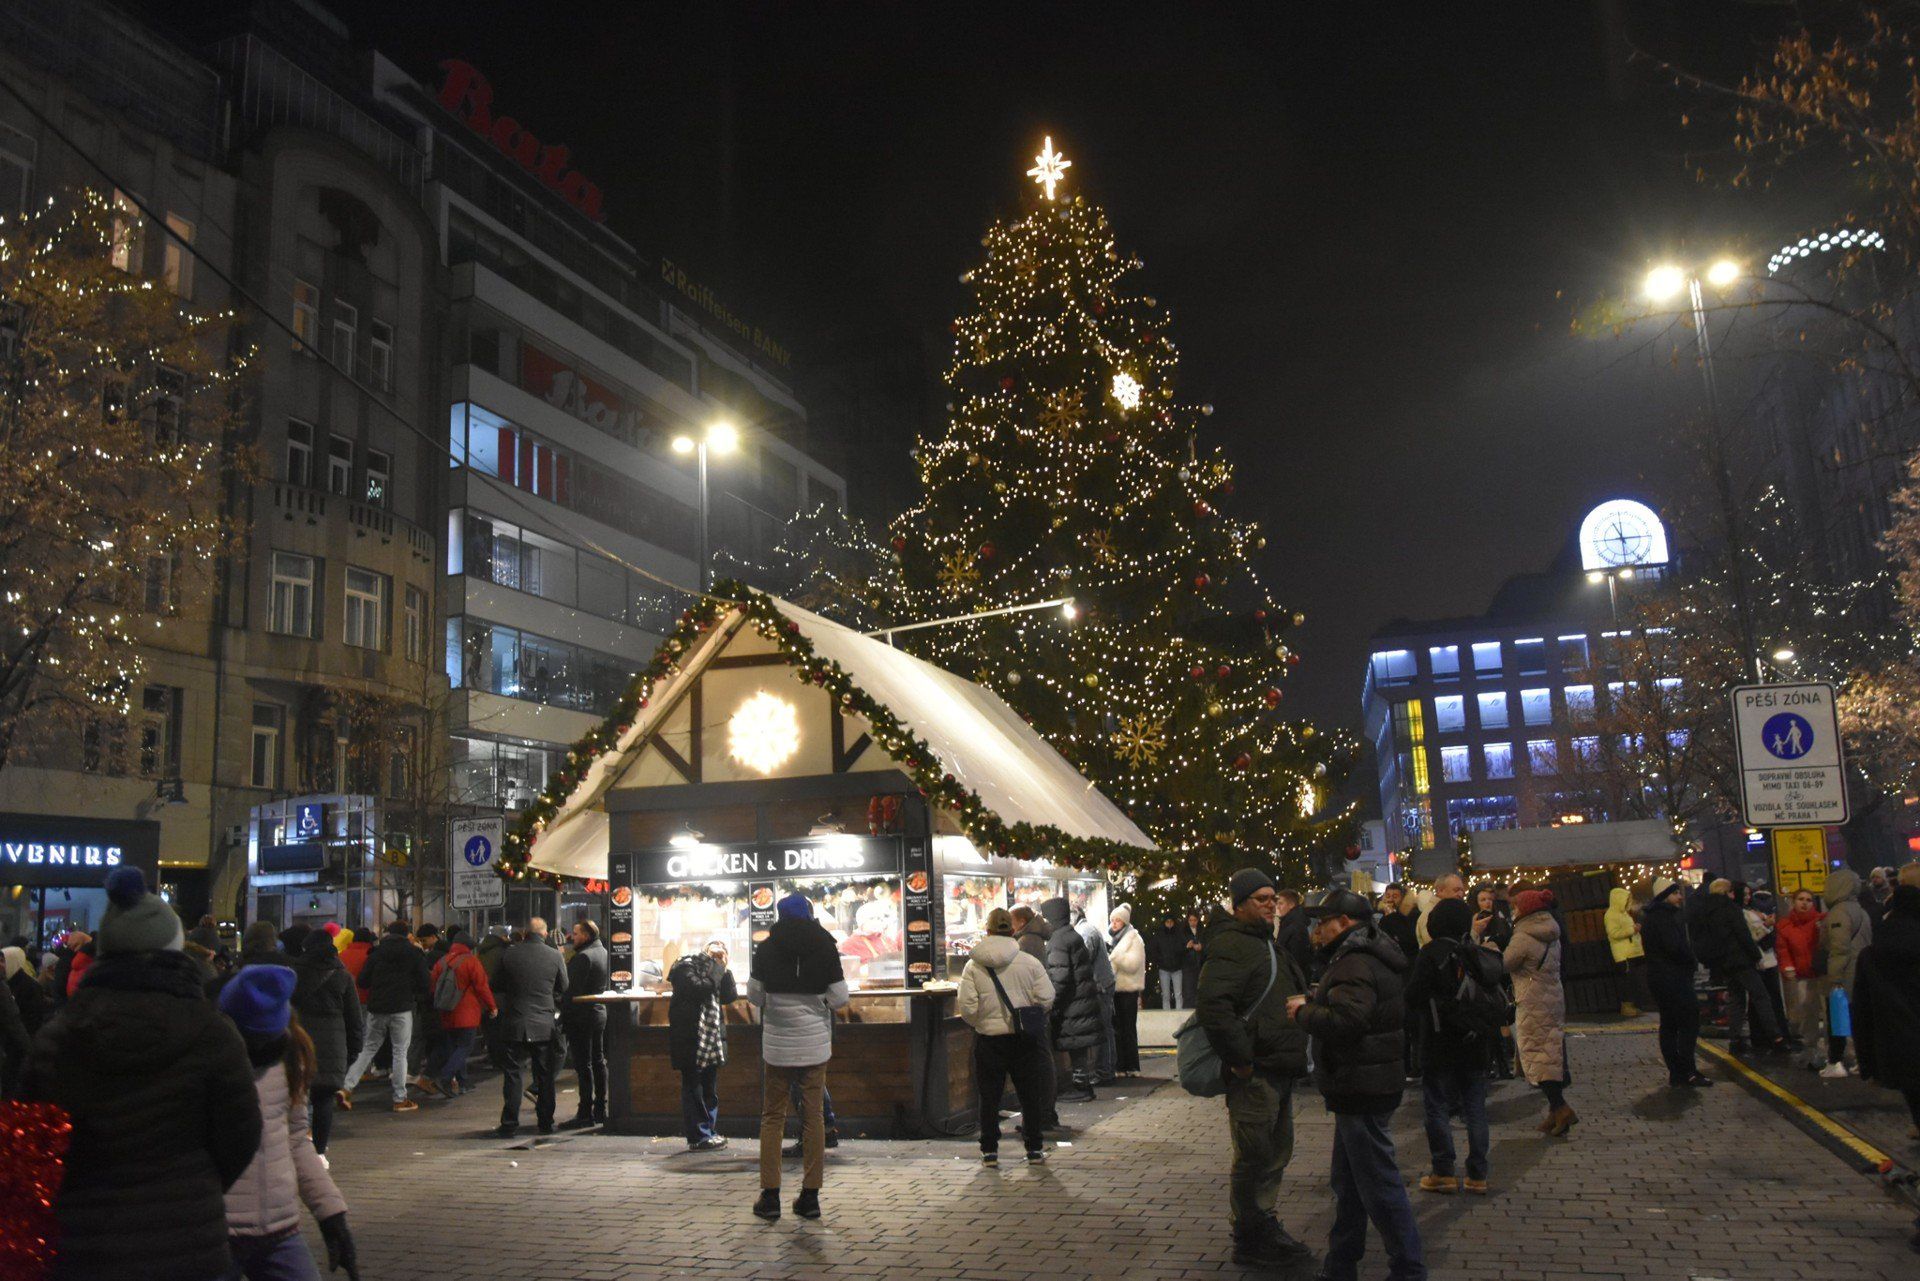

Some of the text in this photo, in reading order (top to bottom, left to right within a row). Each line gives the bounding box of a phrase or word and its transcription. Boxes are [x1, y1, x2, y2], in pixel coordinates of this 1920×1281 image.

[677, 267, 792, 369] Raiffeisen BANK
[1746, 690, 1822, 708] PĚŠÍ ZÓNA
[1758, 771, 1826, 781] DOPRAVNÍ OBSLUHA
[1762, 782, 1782, 791] MIMO
[1785, 782, 1800, 790] TAXI
[1753, 801, 1838, 812] VOZIDLA SE SOUHLASEM
[1788, 811, 1812, 820] PRAHA
[0, 843, 121, 865] VENIRS
[667, 848, 865, 878] CCKEN & DRINS
